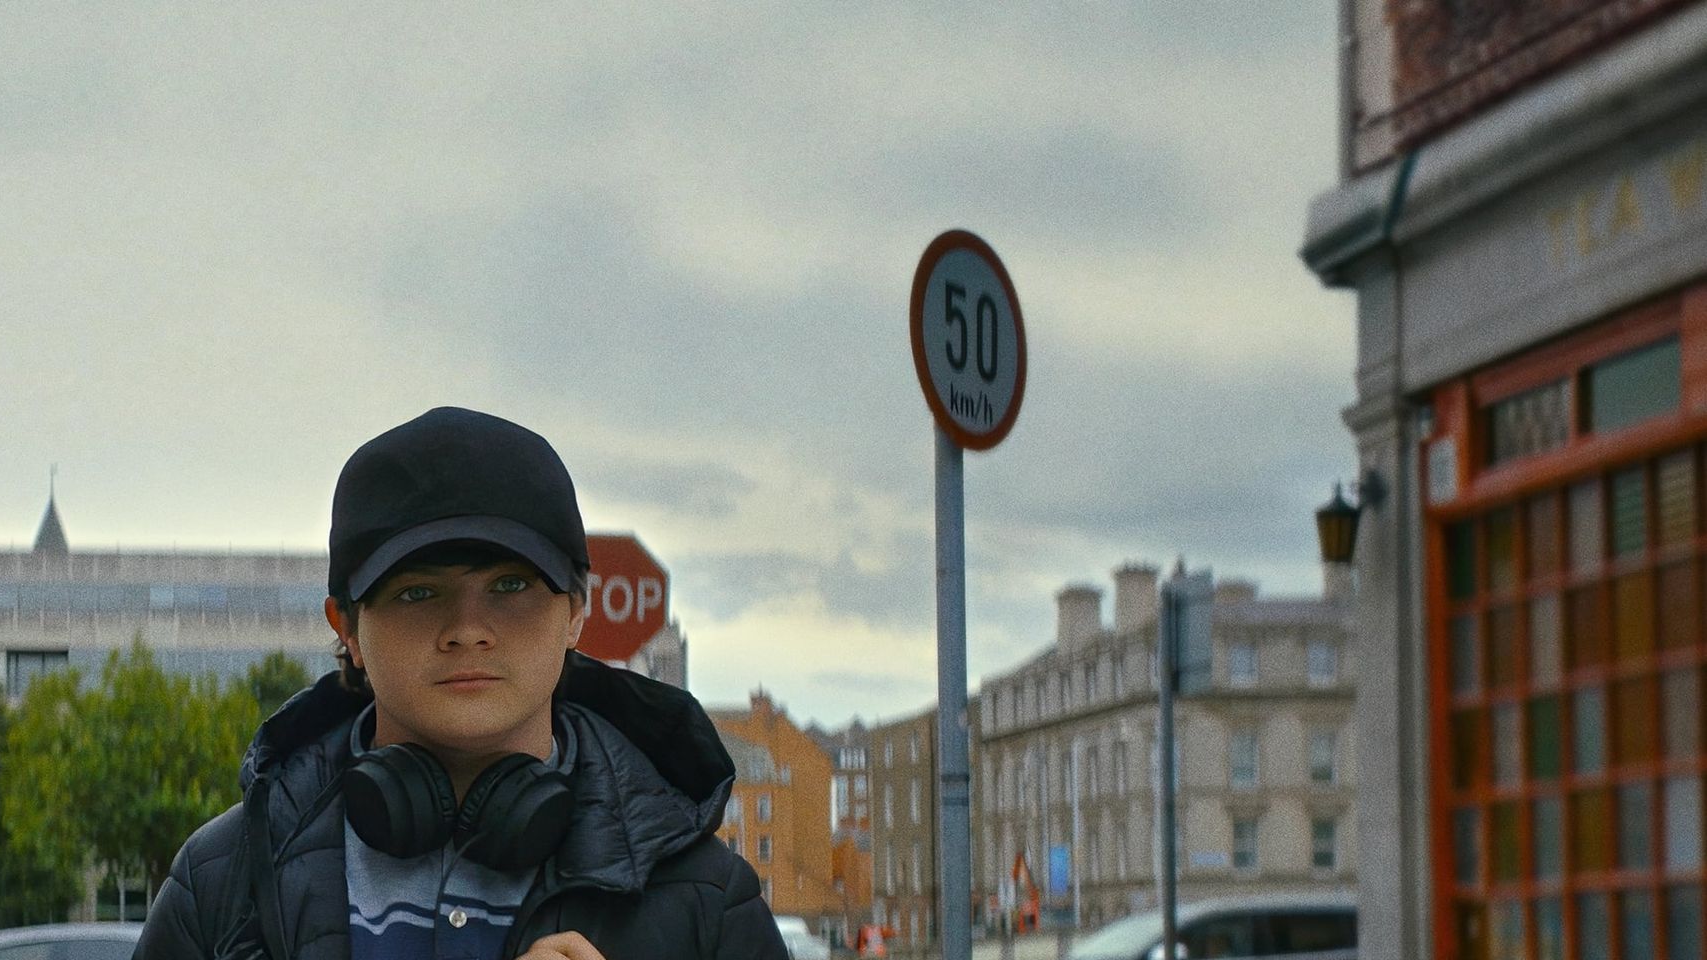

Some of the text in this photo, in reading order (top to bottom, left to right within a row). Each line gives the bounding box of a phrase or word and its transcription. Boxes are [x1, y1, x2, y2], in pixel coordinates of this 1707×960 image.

[944, 279, 999, 386] 50
[950, 382, 995, 426] km/h
[584, 573, 663, 624] TOP
